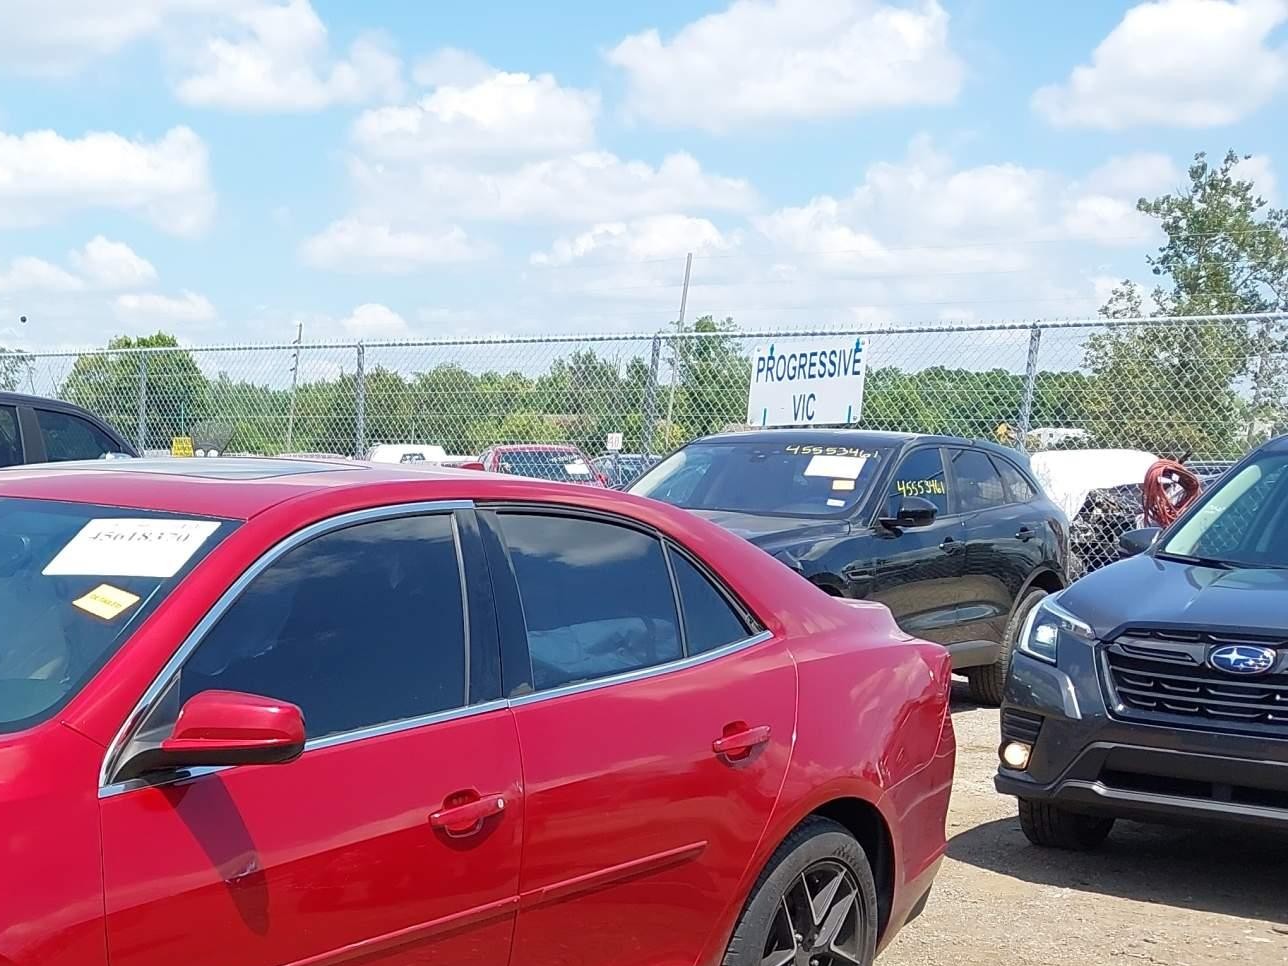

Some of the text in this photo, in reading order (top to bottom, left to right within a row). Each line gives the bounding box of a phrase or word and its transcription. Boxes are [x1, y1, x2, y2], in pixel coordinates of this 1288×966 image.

[755, 348, 863, 383] PROGRESSIVE
[793, 393, 816, 421] VIC
[785, 445, 880, 459] 45553461
[897, 480, 945, 497] 45553461
